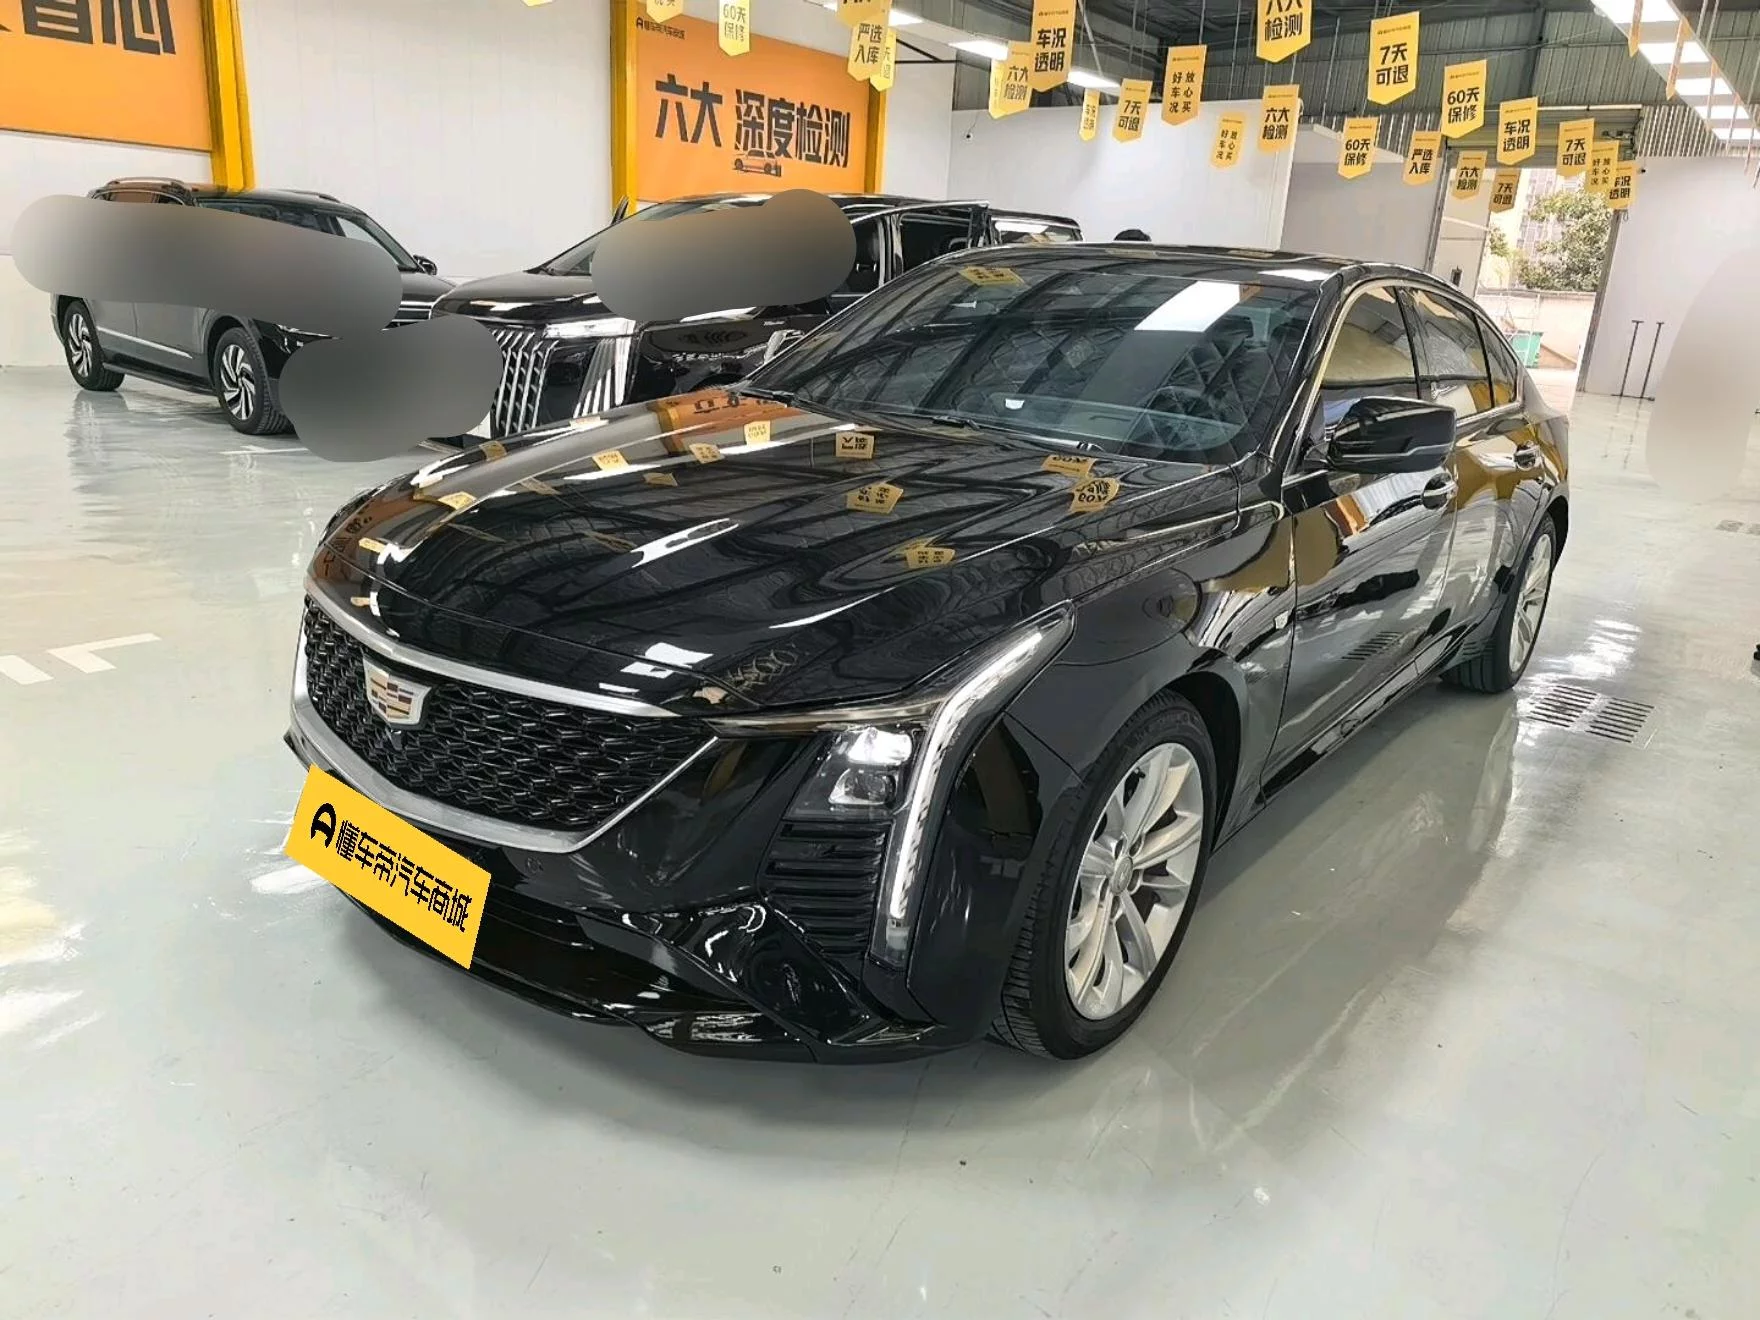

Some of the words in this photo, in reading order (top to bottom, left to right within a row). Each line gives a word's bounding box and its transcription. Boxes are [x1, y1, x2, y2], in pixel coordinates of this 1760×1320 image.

[723, 3, 747, 23] 60天
[858, 22, 883, 44] 严选
[1264, 12, 1303, 41] 检测
[1037, 28, 1067, 49] 车况
[855, 45, 880, 64] 入库
[1034, 51, 1065, 72] 透明
[1379, 42, 1408, 65] 7天
[1007, 65, 1028, 82] 六大
[1375, 64, 1409, 86] 可退
[1169, 72, 1183, 113] 好车况
[1181, 71, 1196, 113] 放心买
[1447, 86, 1480, 106] 60天
[1123, 99, 1142, 116] 7天
[1265, 107, 1290, 123] 六大
[1447, 105, 1478, 124] 保修
[655, 72, 723, 148] 六大
[734, 89, 850, 169] 深度检测
[1117, 115, 1140, 132] 可退
[1504, 118, 1531, 135] 车况
[1262, 123, 1288, 141] 检测
[1344, 138, 1371, 153] 60天
[1502, 135, 1530, 153] 透明
[1565, 138, 1586, 152] 7天
[1343, 151, 1367, 167] 保修
[1411, 149, 1433, 161] 严选
[1562, 152, 1586, 166] 可退
[1408, 161, 1430, 175] 入库
[1459, 166, 1478, 178] 六大
[1498, 181, 1513, 193] 7天
[1609, 188, 1630, 200] 透明
